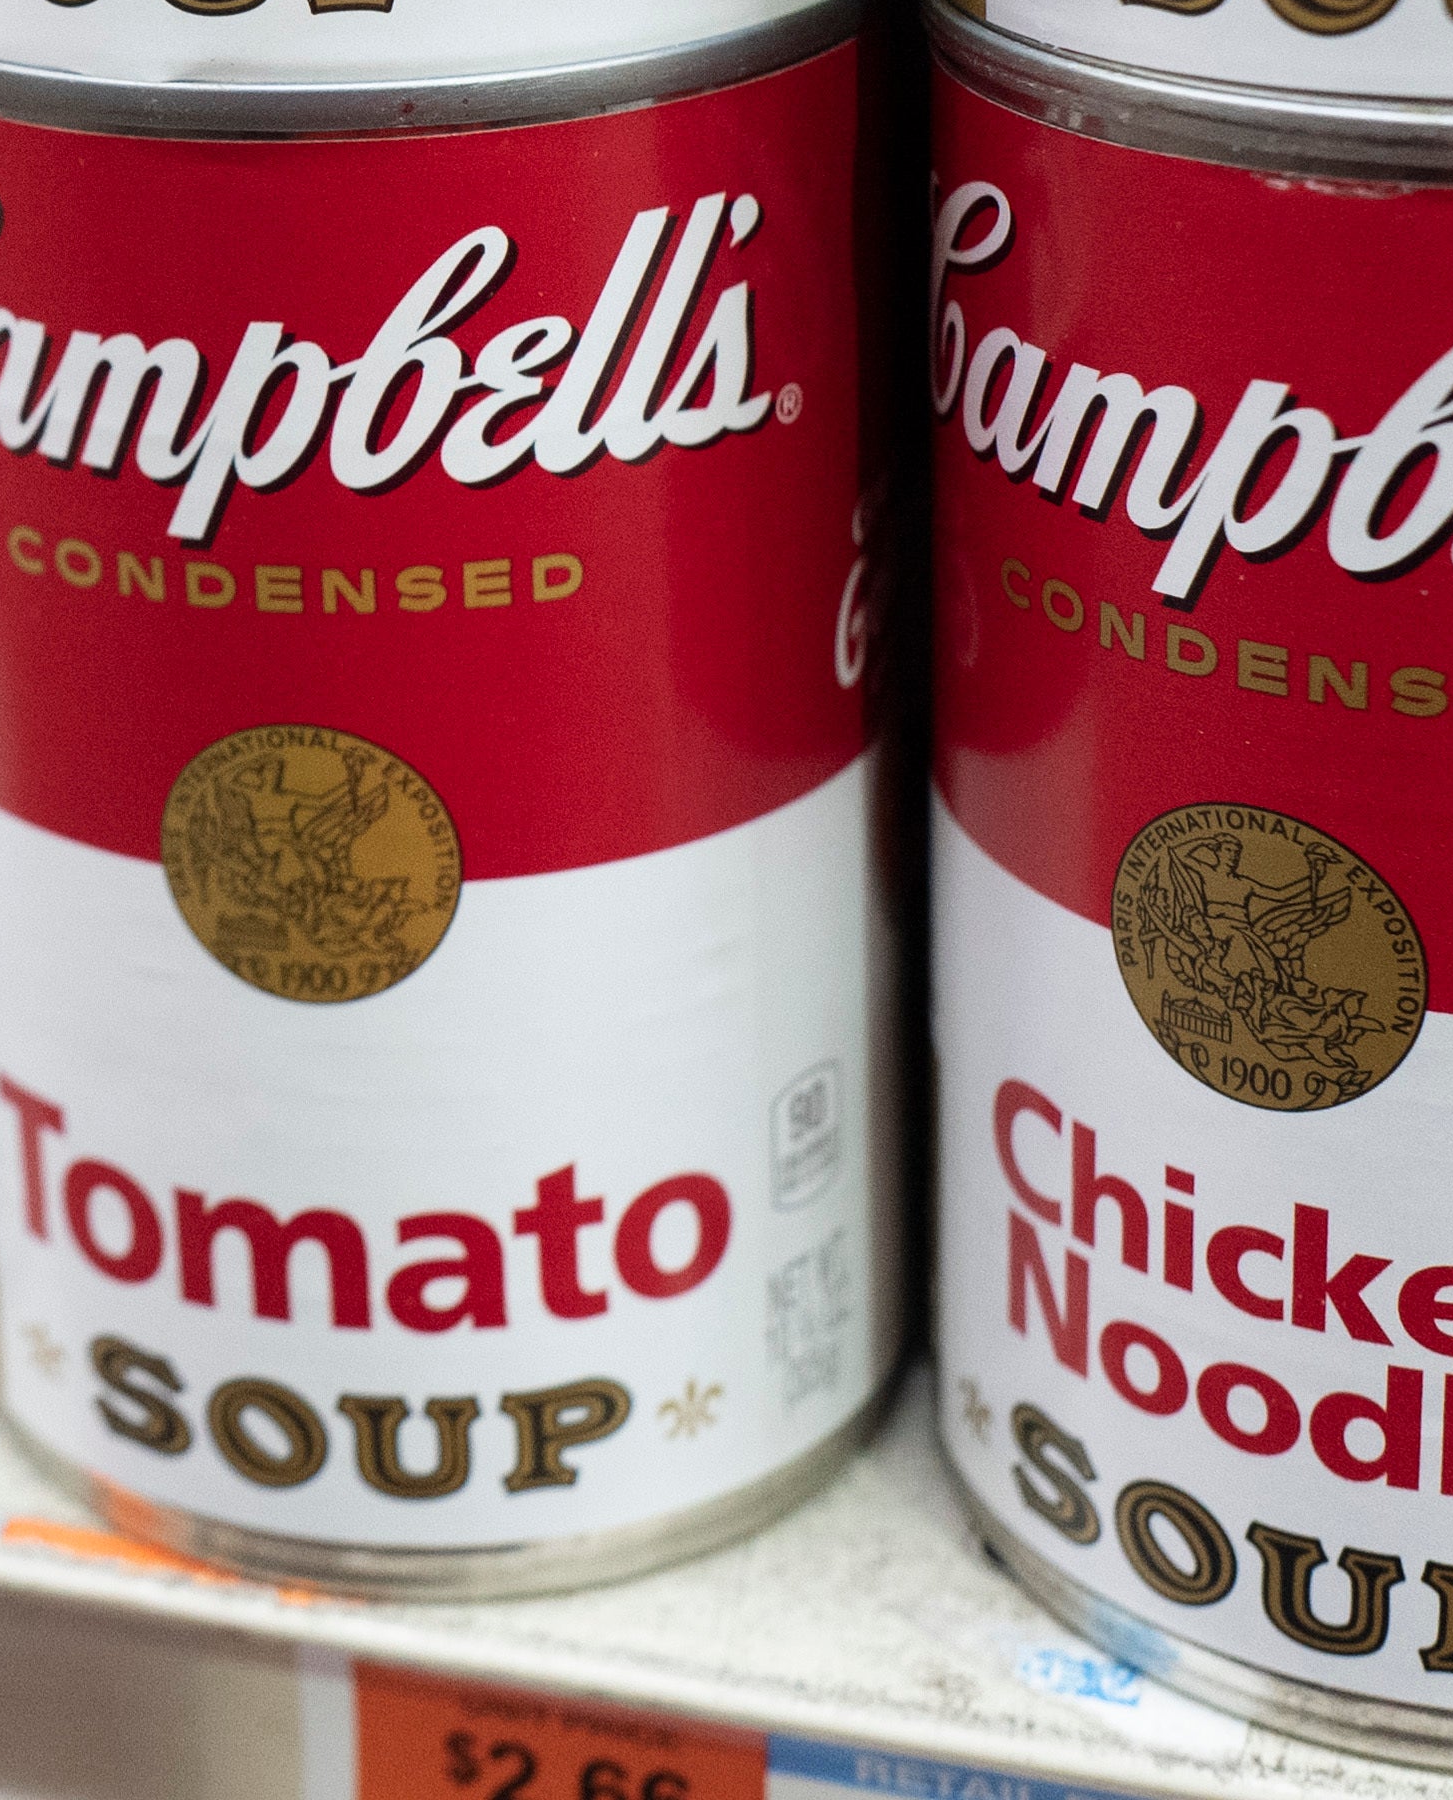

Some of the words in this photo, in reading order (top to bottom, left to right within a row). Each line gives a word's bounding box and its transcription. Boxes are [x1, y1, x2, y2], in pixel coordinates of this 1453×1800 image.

[6, 525, 585, 616] CONDENSED
[1125, 808, 1307, 883] INTERNATIONAL
[1115, 890, 1138, 967] PARIS
[1344, 864, 1421, 1037] EXPOSITION
[1219, 1054, 1293, 1101] 1900
[90, 1335, 633, 1500] SOUP
